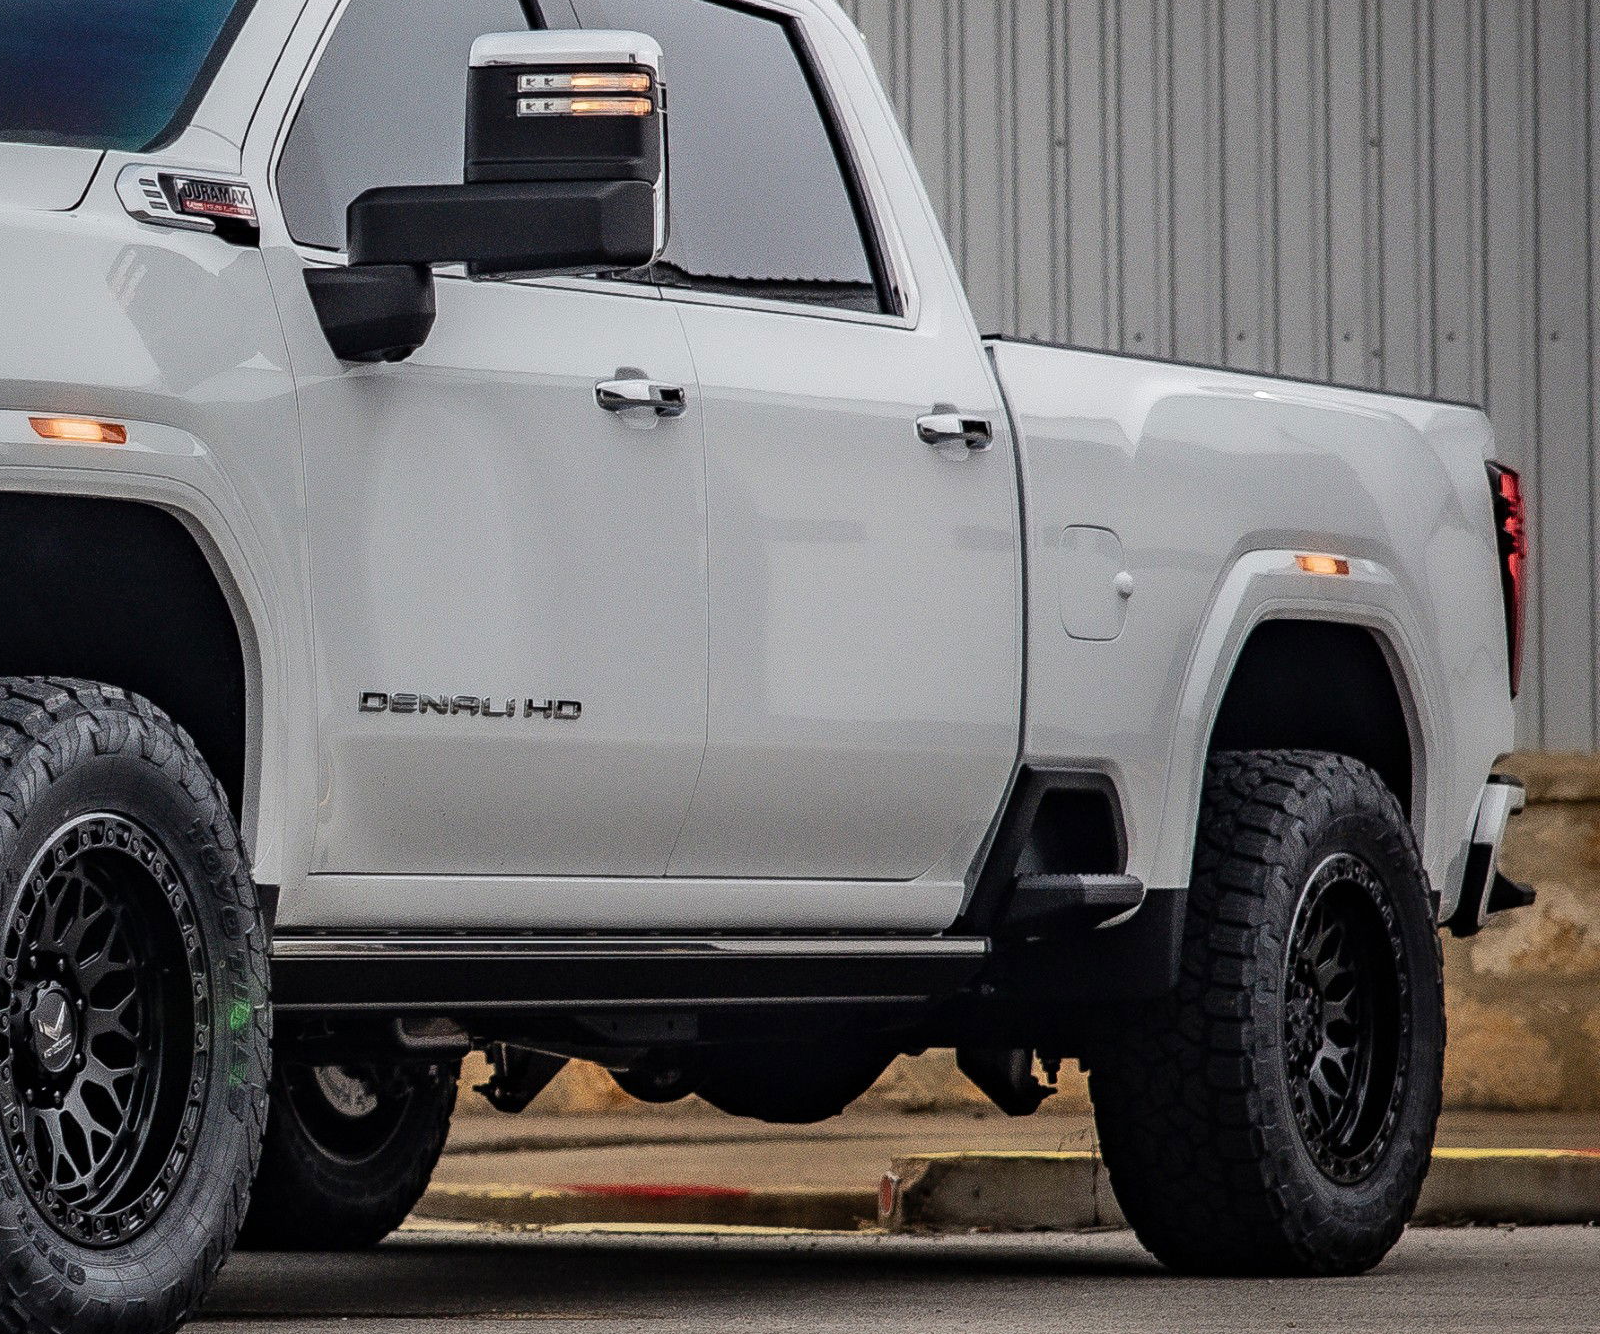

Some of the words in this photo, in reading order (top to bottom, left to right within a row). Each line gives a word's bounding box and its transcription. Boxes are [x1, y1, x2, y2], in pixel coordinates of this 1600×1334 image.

[183, 182, 248, 206] DURAMAX
[358, 690, 516, 719] DENALI
[523, 696, 583, 721] HD
